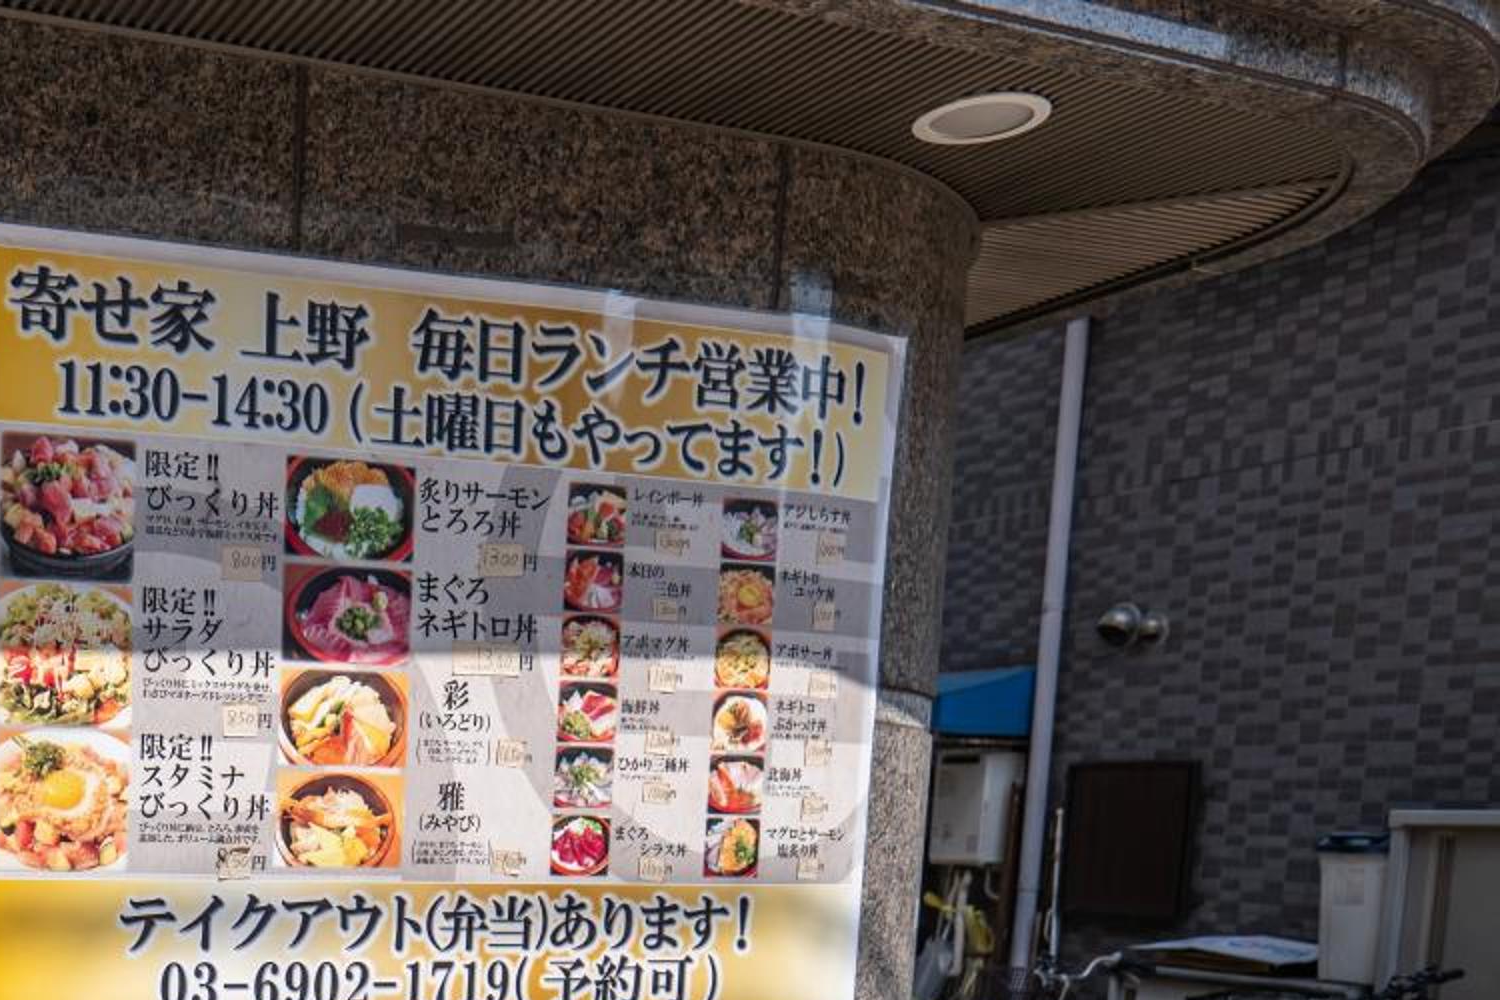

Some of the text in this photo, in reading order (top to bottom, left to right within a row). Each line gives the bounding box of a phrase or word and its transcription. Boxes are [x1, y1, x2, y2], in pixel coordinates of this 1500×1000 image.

[8, 264, 217, 356] 寄せ家
[240, 290, 374, 371] 上野
[57, 358, 849, 488] 11:30-14:30 (土曜日もやってます!)
[146, 484, 280, 519] びっくり丼
[420, 477, 551, 511] 炙りサーモン
[421, 505, 522, 540] とろろ丼
[417, 571, 490, 605] まぐろ
[142, 617, 223, 645] サラダ
[417, 608, 538, 643] ネギトロ丼
[144, 648, 276, 679] びっくり丼
[443, 679, 470, 712] 彩
[143, 763, 245, 791] スタミナ
[139, 792, 271, 821] びっくり丼
[437, 781, 466, 812] 雅
[420, 813, 482, 834] (みやび)
[119, 891, 752, 957] テイクアウト(弁当)あります!
